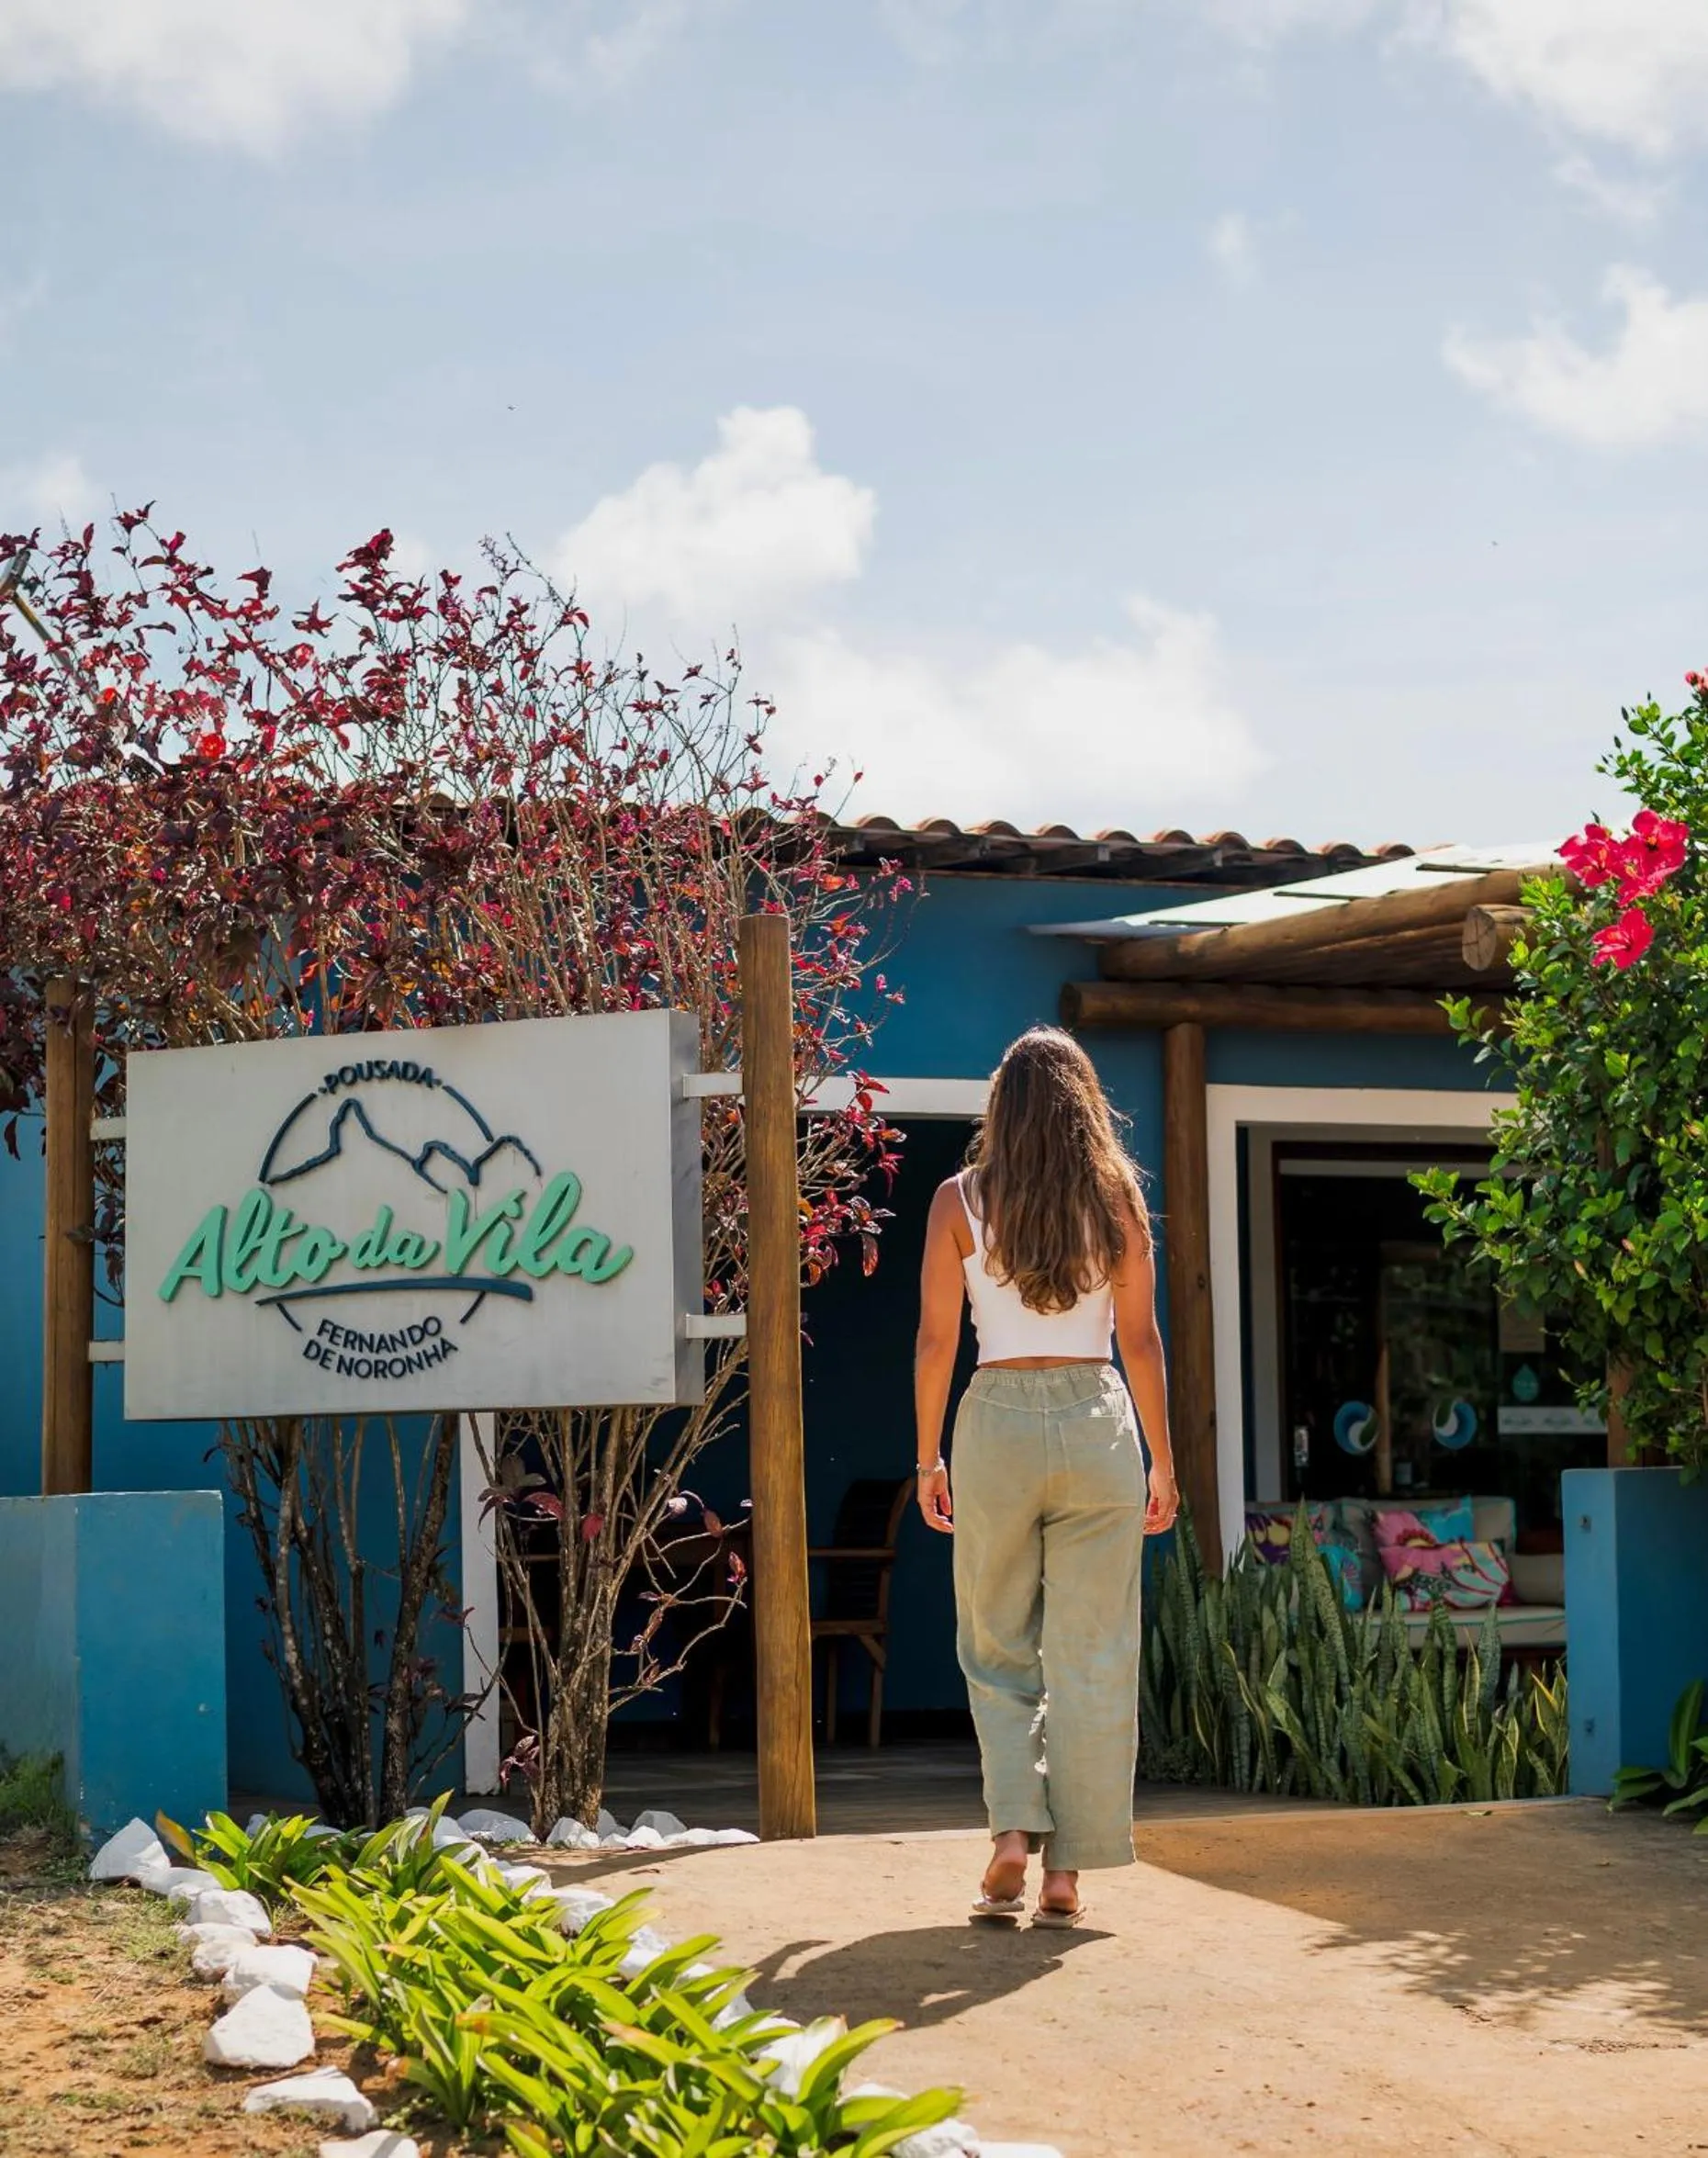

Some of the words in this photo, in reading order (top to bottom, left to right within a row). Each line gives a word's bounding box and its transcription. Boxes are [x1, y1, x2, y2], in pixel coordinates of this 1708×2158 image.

[323, 1060, 433, 1095] POUSADA
[158, 1187, 348, 1302] Alto
[350, 1204, 441, 1270] da
[444, 1171, 635, 1285] Vila
[316, 1315, 443, 1354] FERNANDO
[302, 1339, 337, 1370] DE
[336, 1337, 459, 1379] NORONHA
